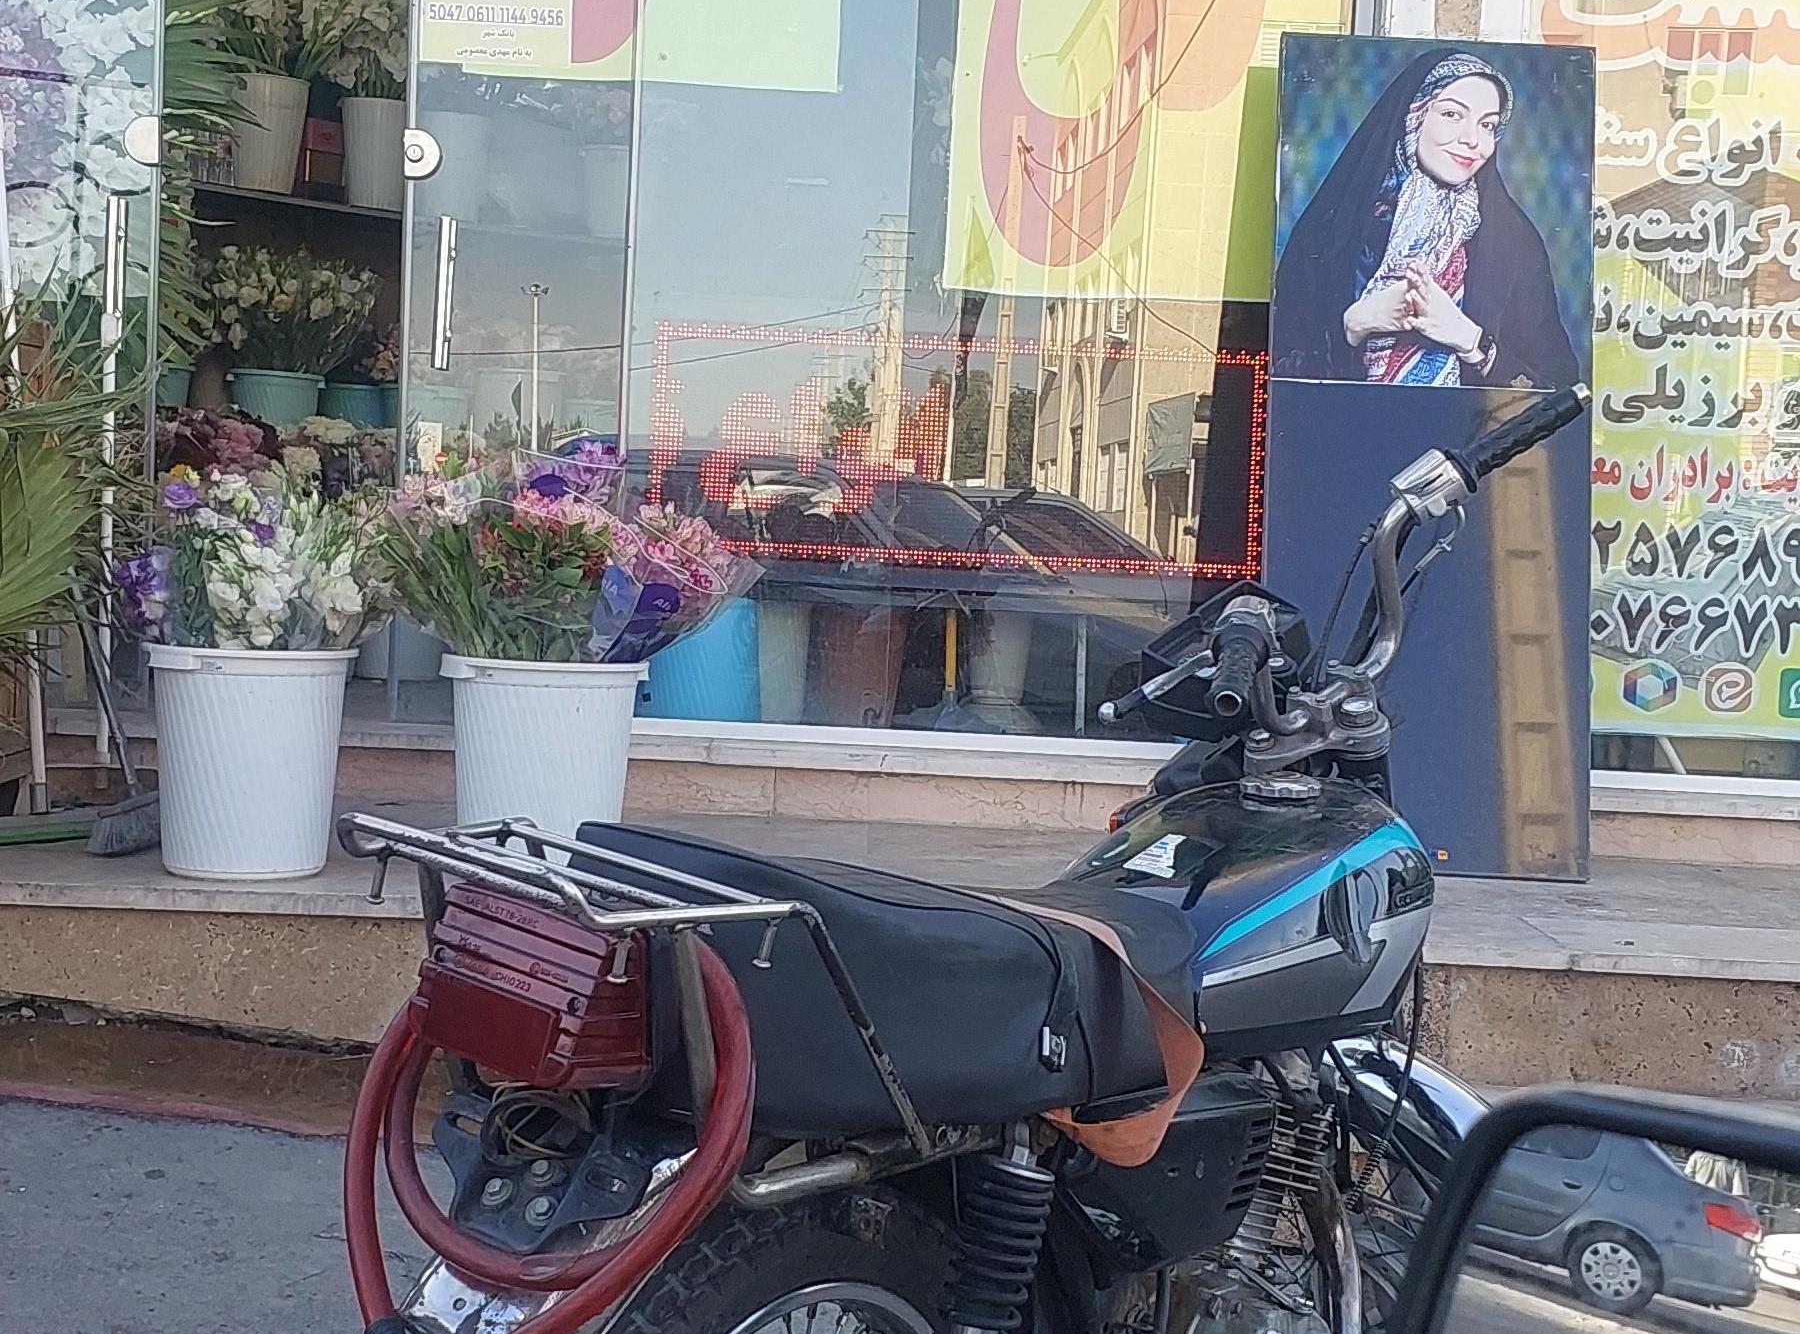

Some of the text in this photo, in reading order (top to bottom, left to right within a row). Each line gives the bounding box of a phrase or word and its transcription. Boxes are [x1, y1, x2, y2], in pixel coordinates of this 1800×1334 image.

[429, 3, 564, 26] 5047 0611 1144 9456
[1662, 117, 1783, 179] انواع
[1601, 362, 1763, 429] برزیلی
